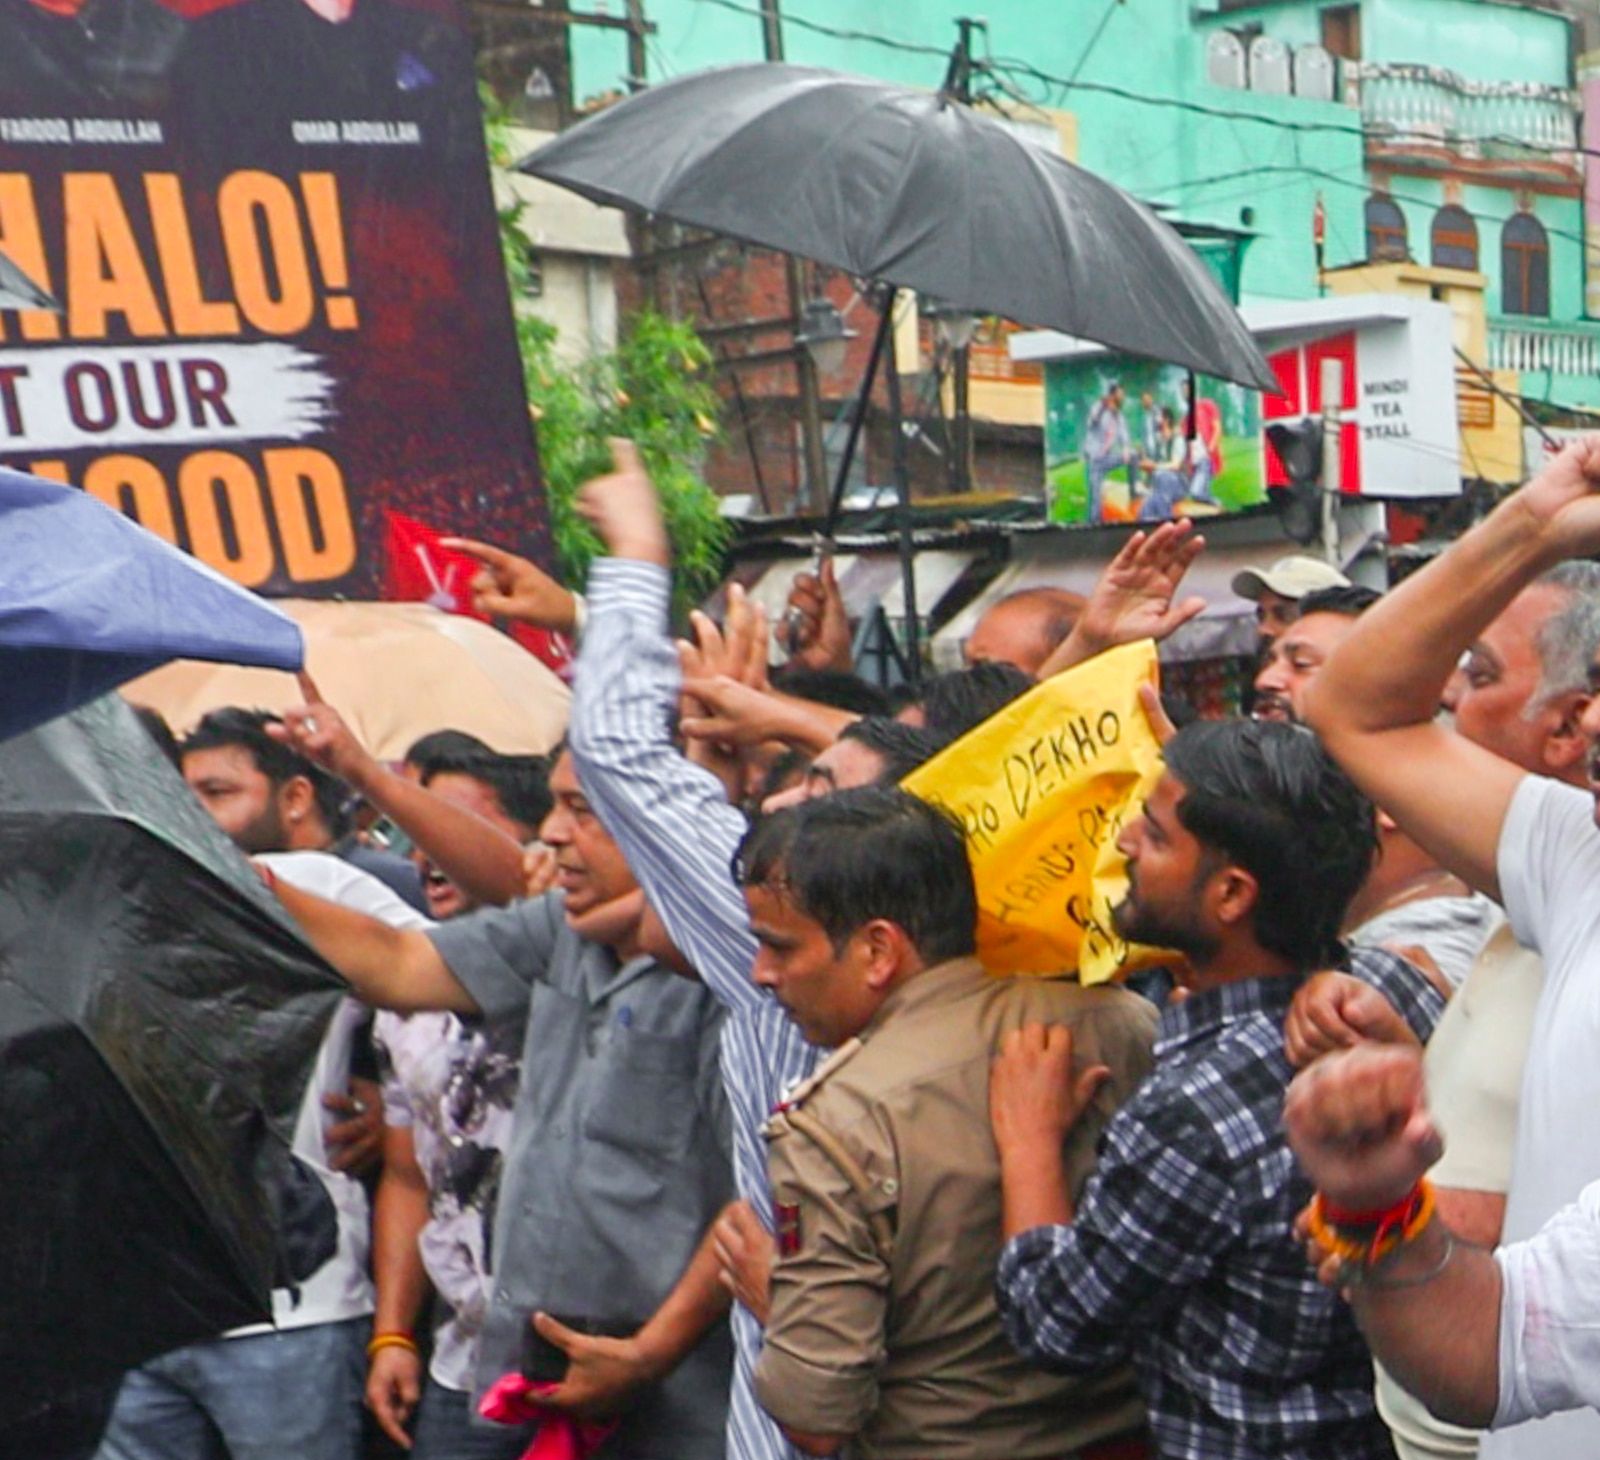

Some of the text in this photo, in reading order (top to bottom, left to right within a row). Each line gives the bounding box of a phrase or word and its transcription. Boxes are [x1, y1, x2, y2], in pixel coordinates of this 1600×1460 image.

[73, 118, 163, 144] ABDULLAH
[291, 120, 420, 144] OMAR ABDULLAH
[63, 358, 238, 433] OUR
[1372, 402, 1403, 418] TEA
[1364, 423, 1412, 441] STALL
[30, 446, 358, 588] OOD
[1003, 709, 1121, 821] DEKHO
